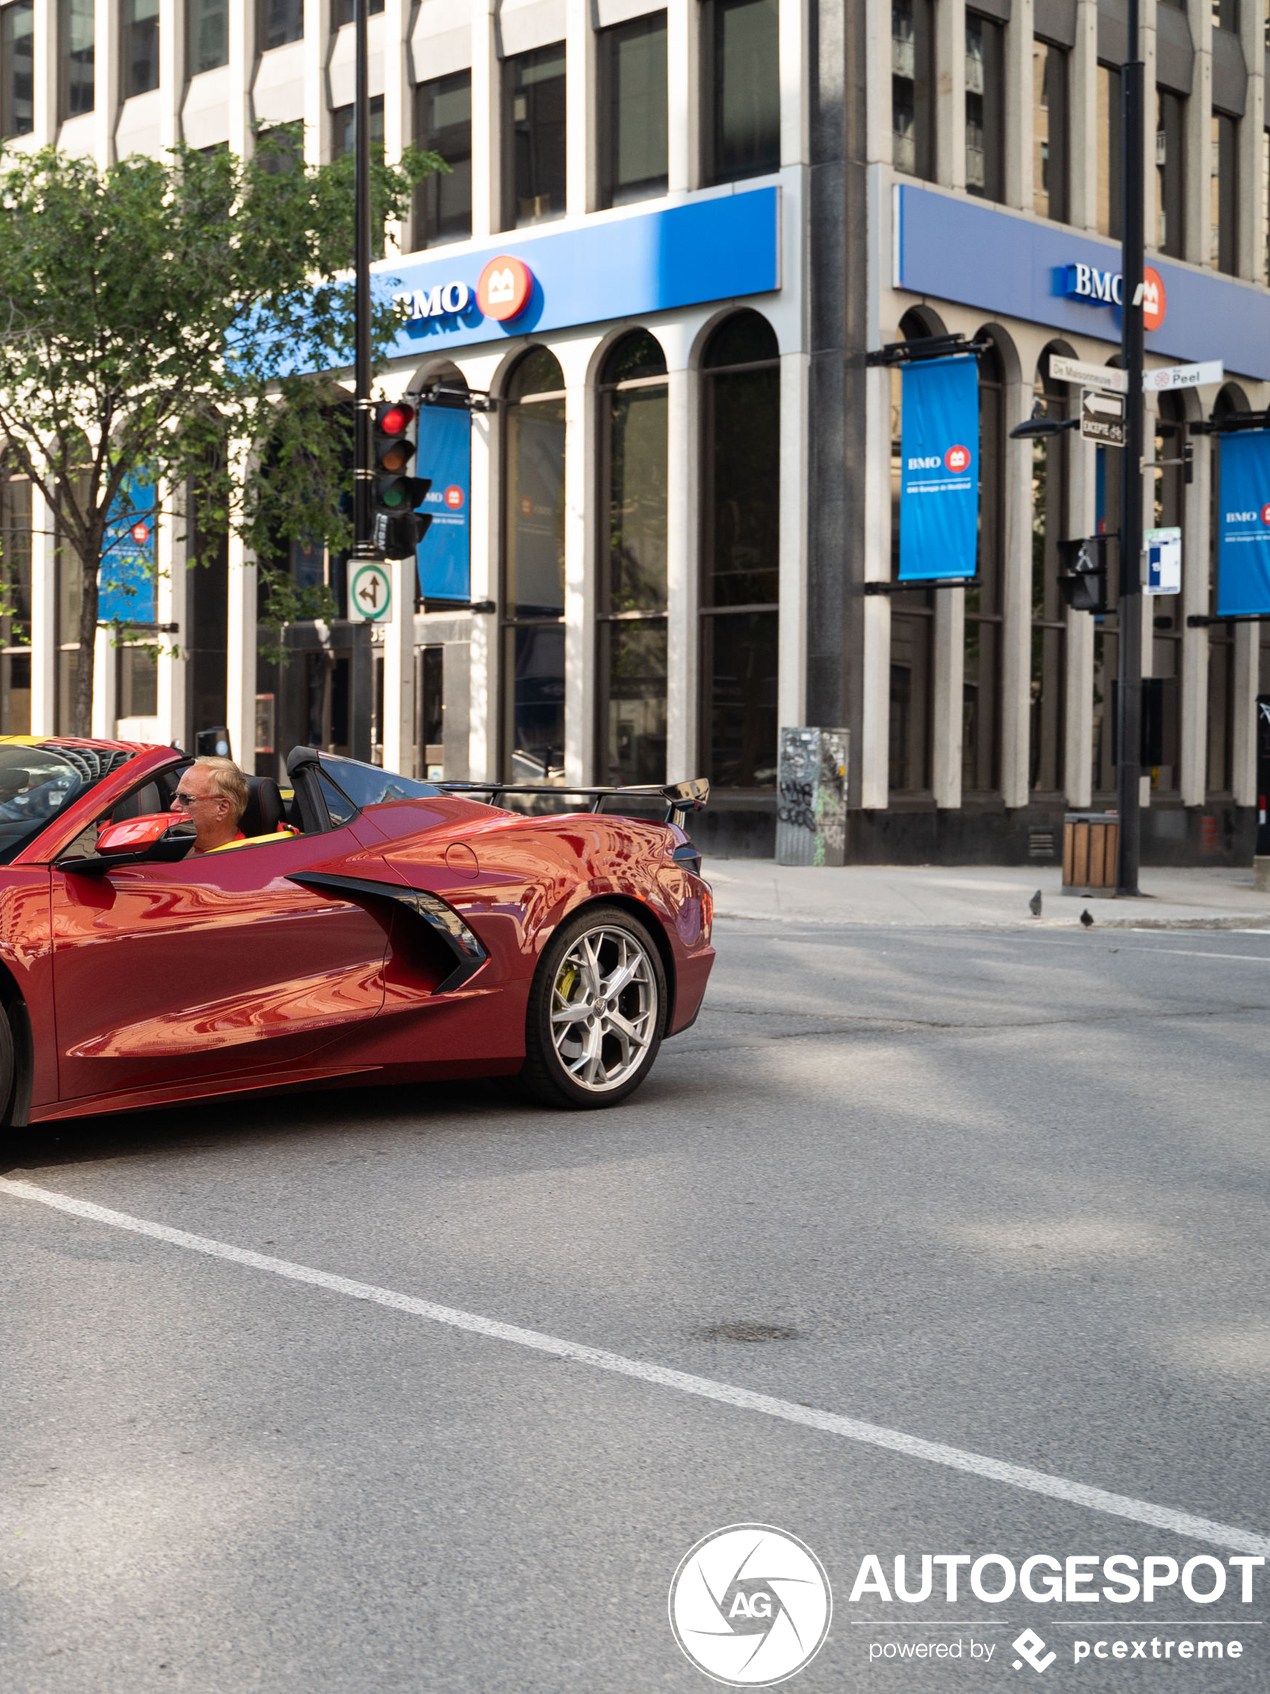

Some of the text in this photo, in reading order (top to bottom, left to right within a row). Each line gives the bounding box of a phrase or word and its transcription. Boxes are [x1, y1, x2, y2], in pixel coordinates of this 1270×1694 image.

[1172, 371, 1200, 384] Peel
[908, 456, 941, 470] BMO
[1226, 511, 1257, 523] BMO
